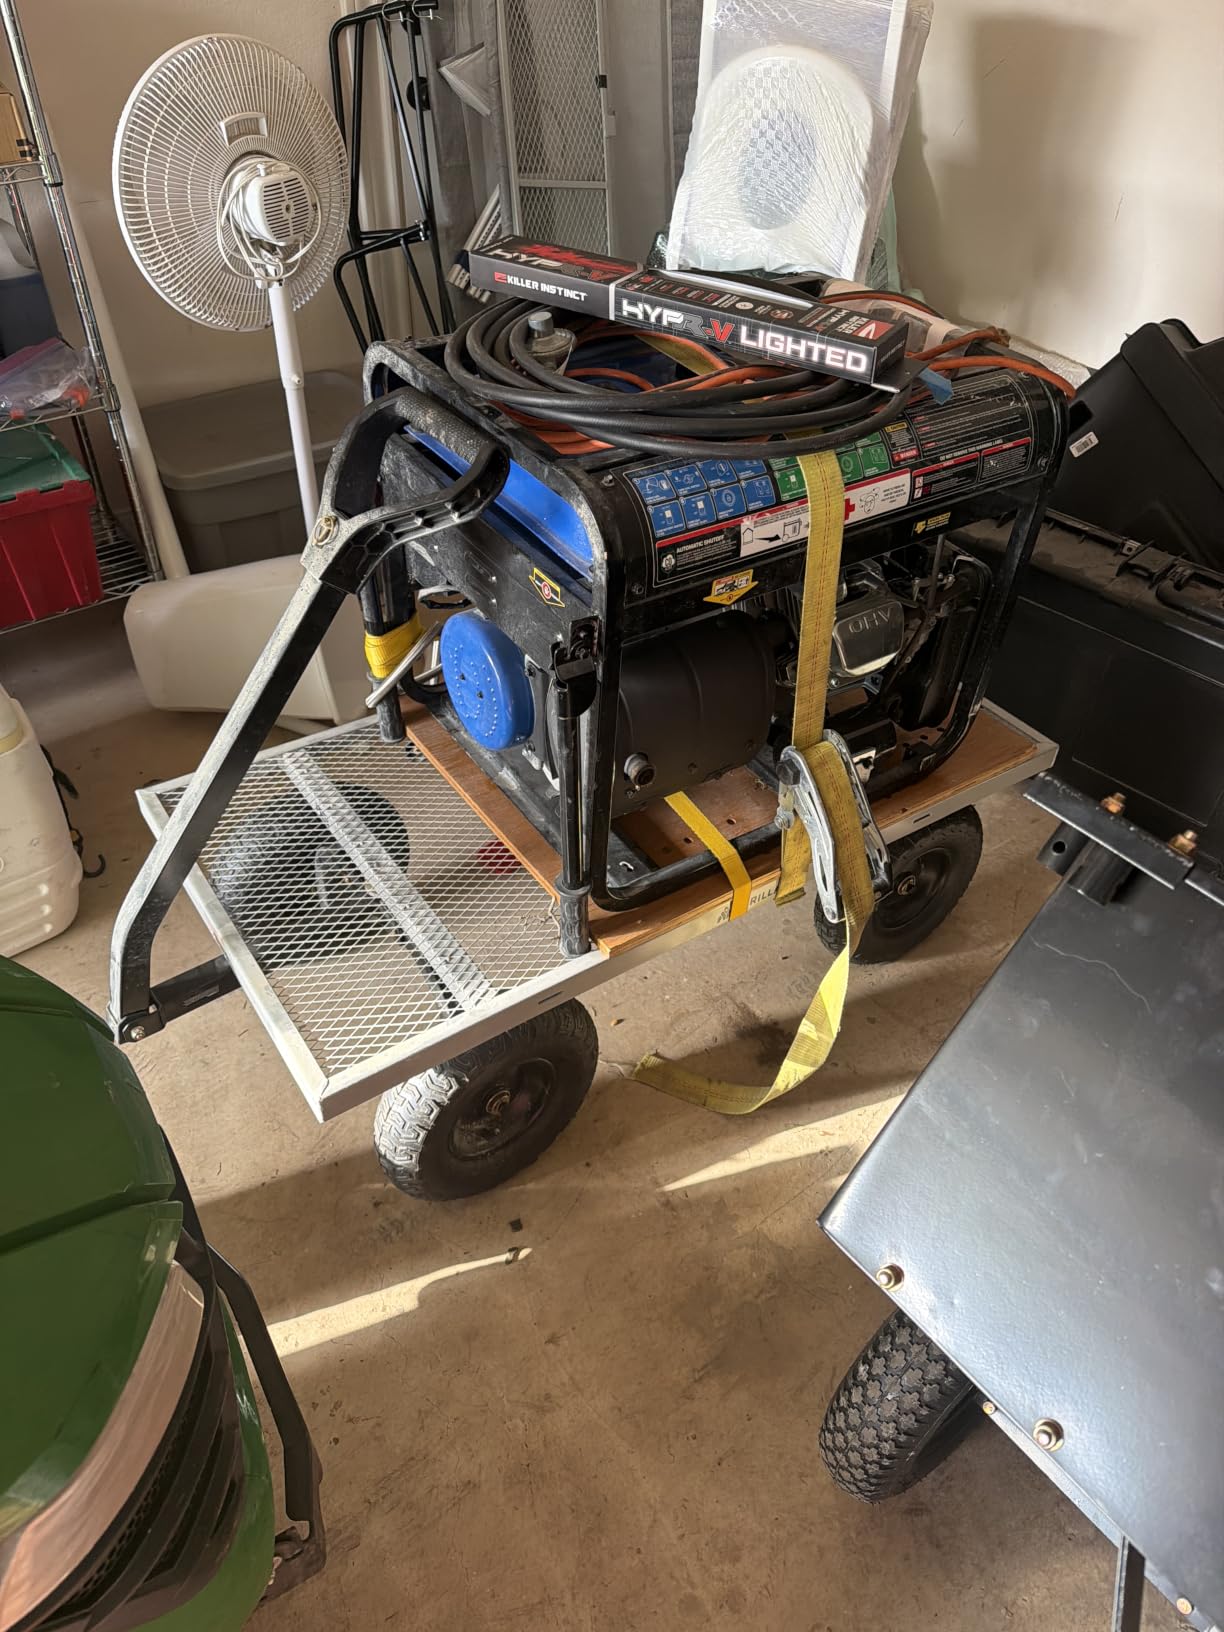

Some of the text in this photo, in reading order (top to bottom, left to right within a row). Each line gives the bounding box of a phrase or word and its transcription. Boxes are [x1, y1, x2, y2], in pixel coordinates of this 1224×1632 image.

[506, 275, 588, 302] KILLER INSTINCT
[740, 325, 869, 373] LIGHTED
[676, 534, 725, 554] AUTOMATIC SHUTOFF
[848, 606, 894, 633] OHV
